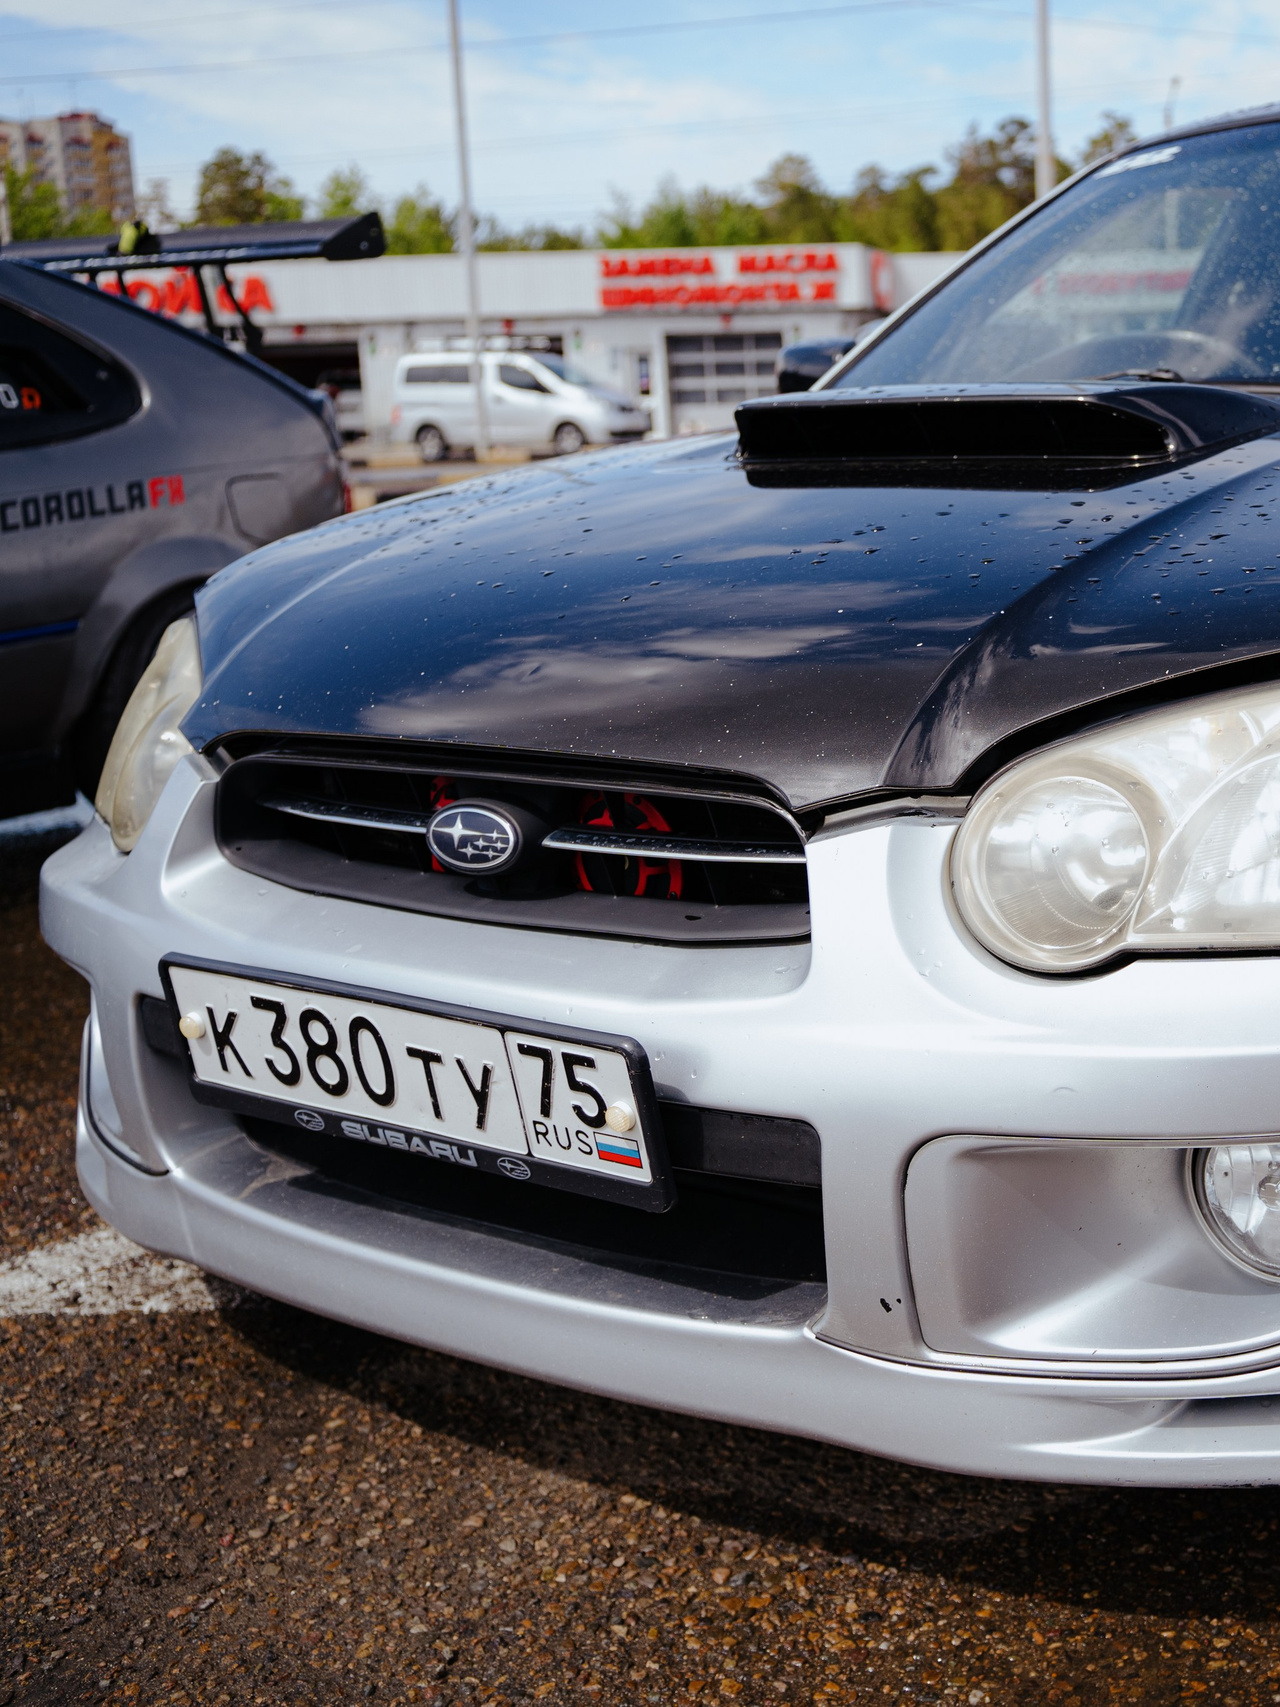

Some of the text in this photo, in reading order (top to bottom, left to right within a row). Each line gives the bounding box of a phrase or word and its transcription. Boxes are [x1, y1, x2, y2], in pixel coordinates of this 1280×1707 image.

[517, 1042, 608, 1129] 75
[340, 1120, 478, 1168] SUBARU
[533, 1119, 594, 1157] RUS
